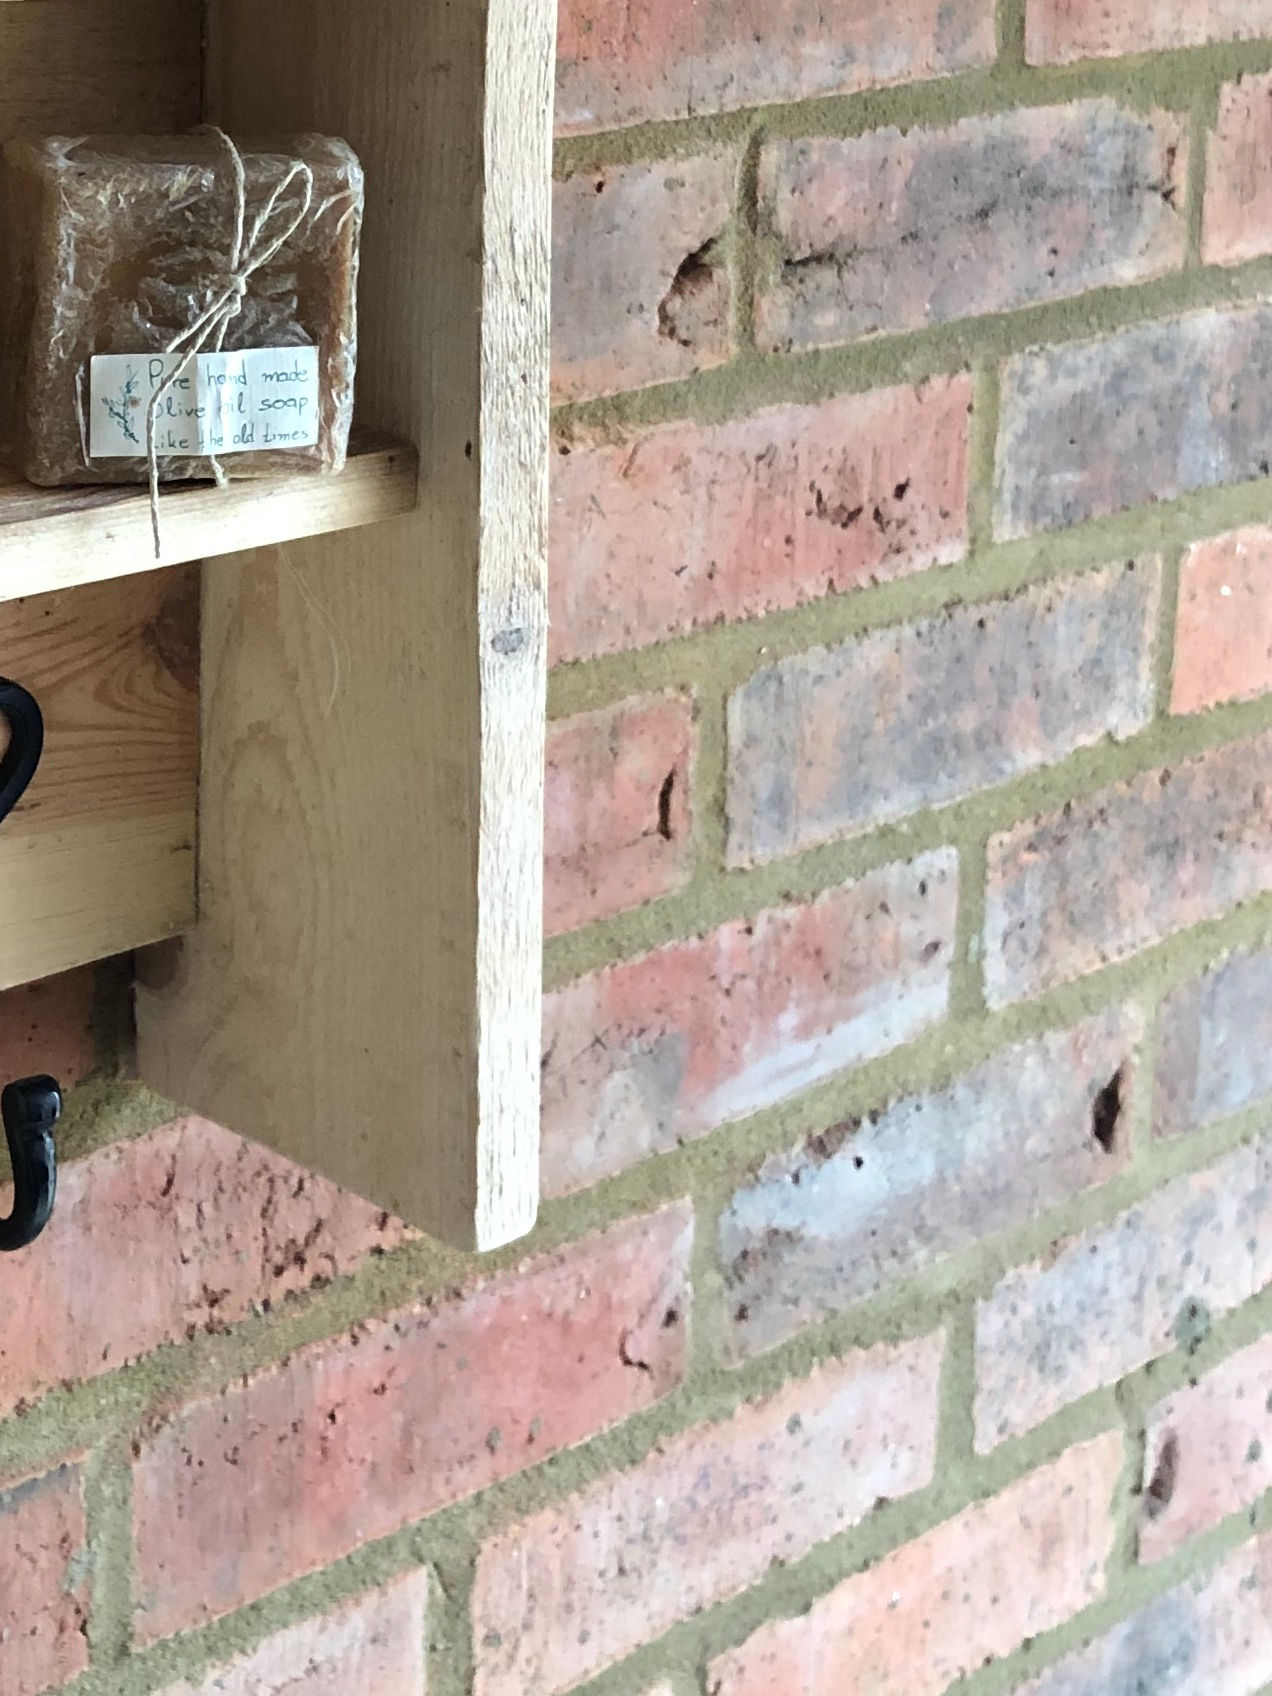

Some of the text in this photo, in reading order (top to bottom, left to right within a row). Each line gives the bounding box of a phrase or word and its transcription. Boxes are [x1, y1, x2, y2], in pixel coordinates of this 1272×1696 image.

[148, 358, 191, 389] Pre
[261, 359, 308, 383] made
[258, 397, 308, 416] soap
[153, 429, 190, 449] ike
[233, 422, 255, 444] old
[263, 422, 309, 443] times
